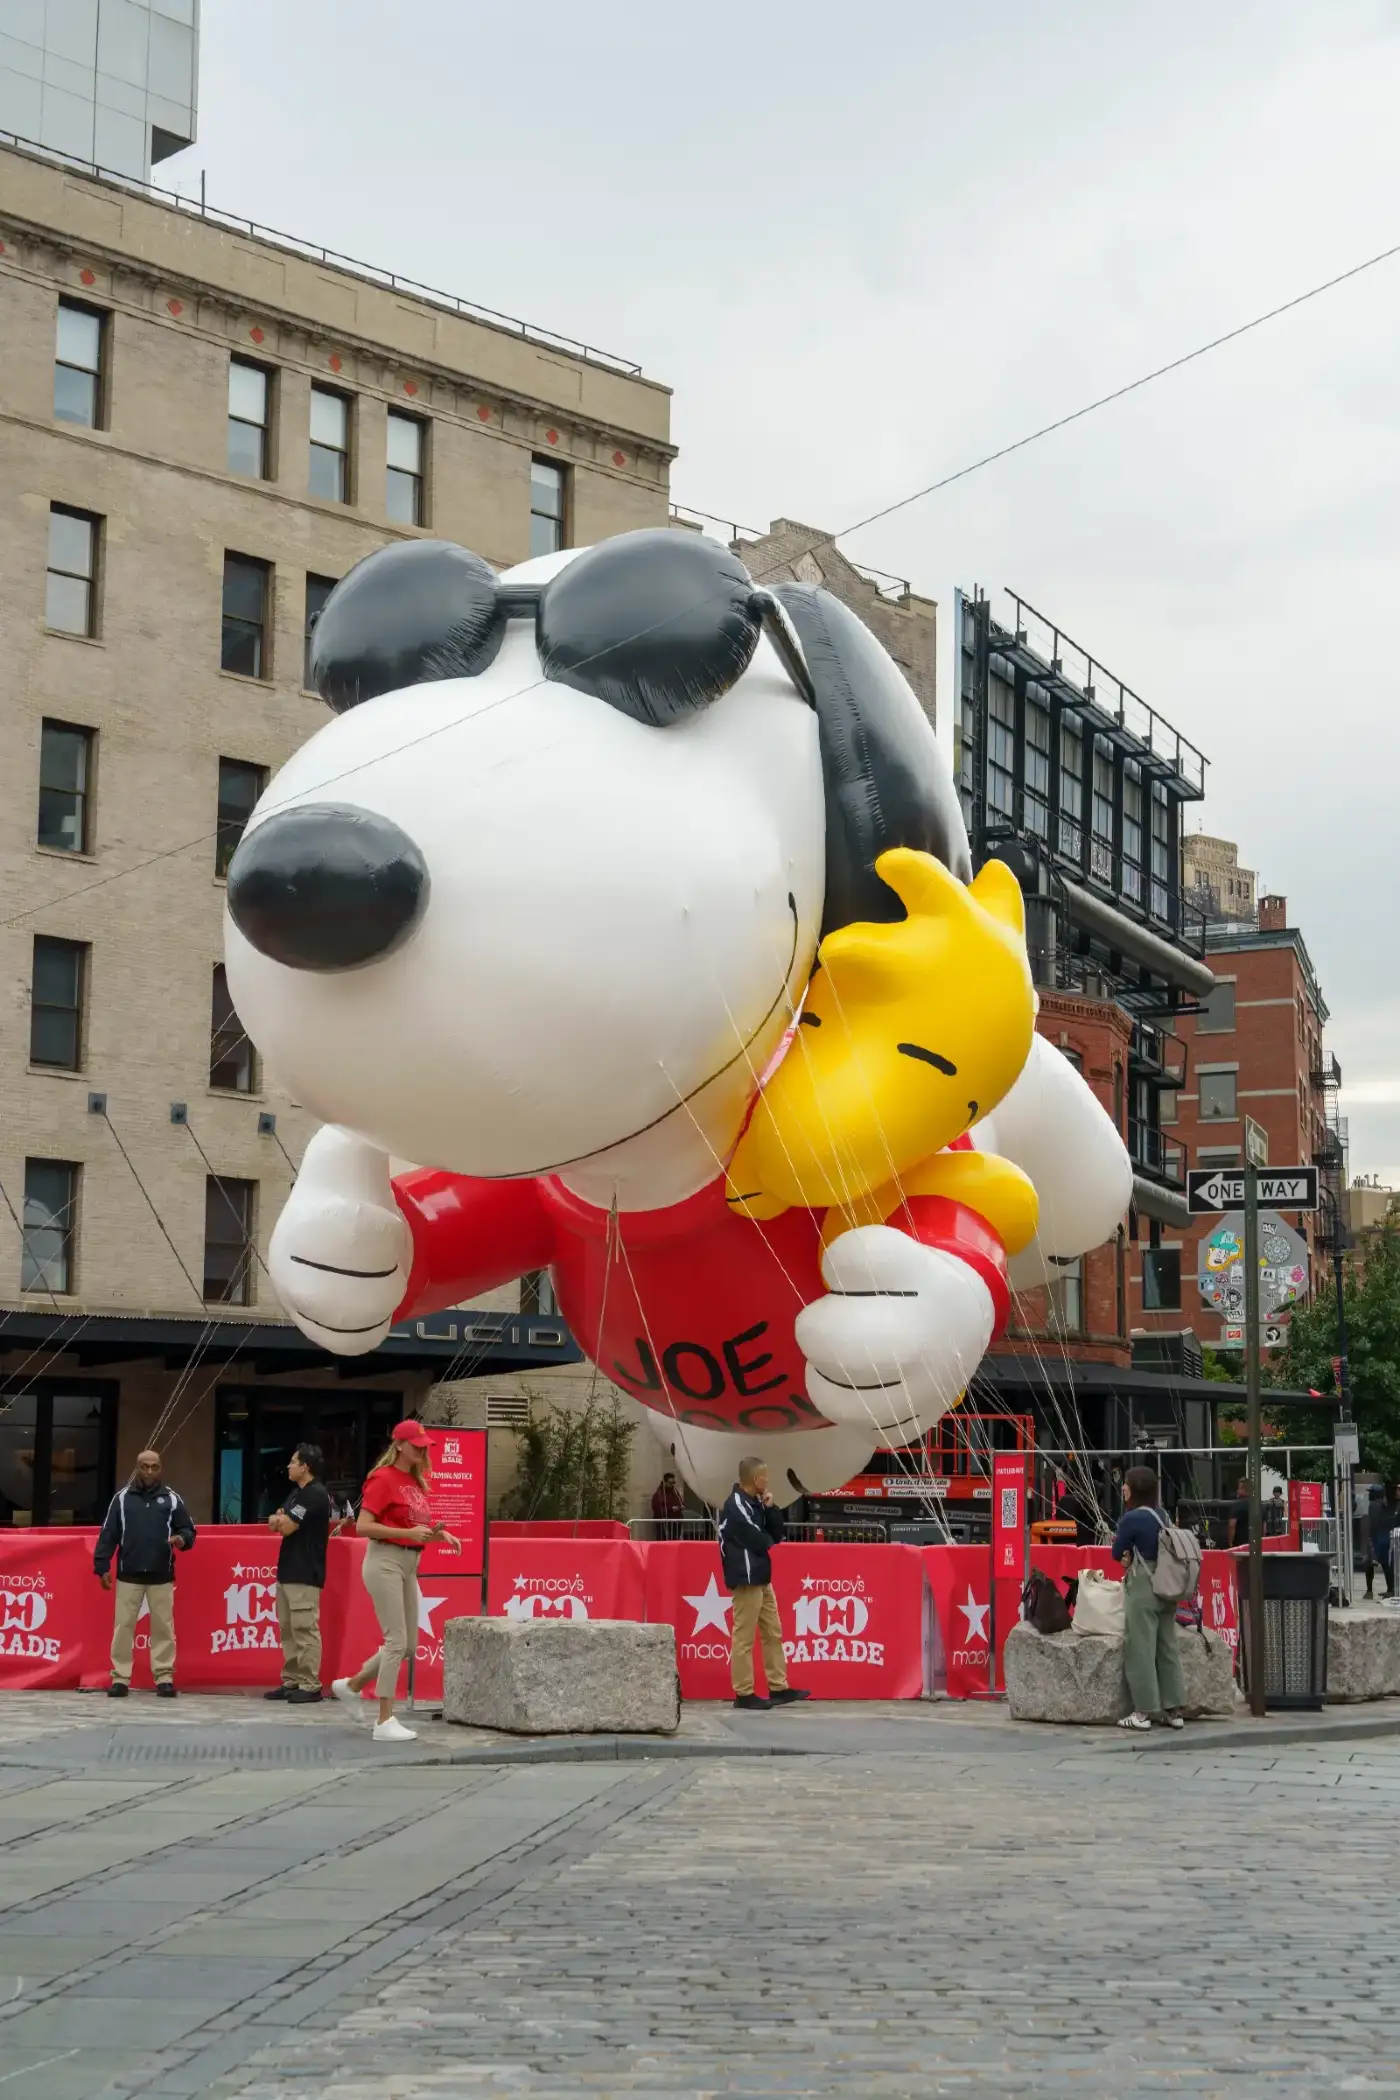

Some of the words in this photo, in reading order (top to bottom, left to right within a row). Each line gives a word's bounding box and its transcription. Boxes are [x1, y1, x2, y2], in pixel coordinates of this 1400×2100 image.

[1207, 1183, 1243, 1199] ONE
[1260, 1180, 1300, 1197] WAY
[612, 1320, 788, 1400] JOE
[246, 1565, 278, 1578] mac
[529, 1573, 584, 1593] macy's
[815, 1574, 865, 1595] macy's
[0, 1632, 61, 1662] ADE
[210, 1626, 283, 1654] PARA
[681, 1643, 732, 1665] macy
[782, 1637, 885, 1667] PARADE
[952, 1649, 990, 1668] macy
